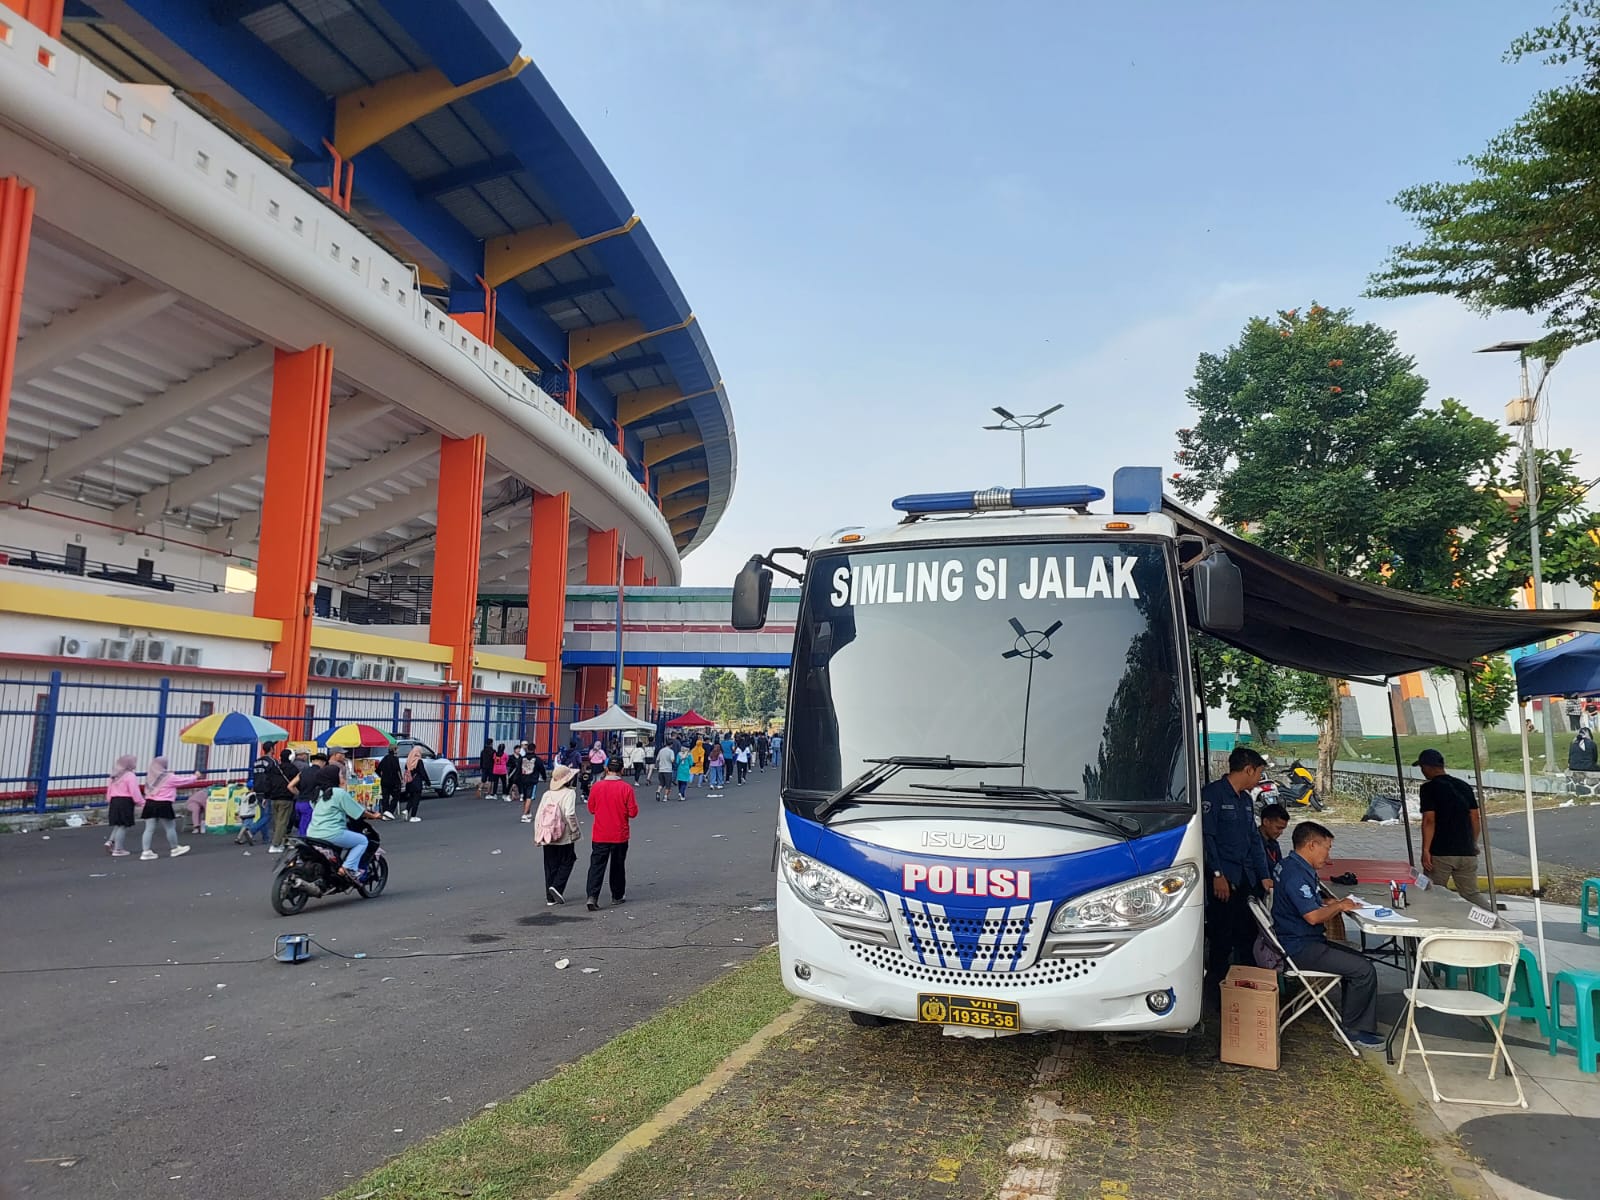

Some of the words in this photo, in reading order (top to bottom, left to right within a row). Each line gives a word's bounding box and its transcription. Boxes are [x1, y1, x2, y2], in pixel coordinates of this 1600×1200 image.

[830, 559, 964, 608] SIMLING
[974, 557, 1007, 601] SI
[1019, 555, 1140, 600] JALAK
[921, 830, 1006, 850] ISUZU
[903, 864, 1031, 898] POLISI
[1470, 909, 1495, 926] TUTUP
[970, 1000, 998, 1010] VIII
[952, 1009, 1014, 1027] 1935-38
